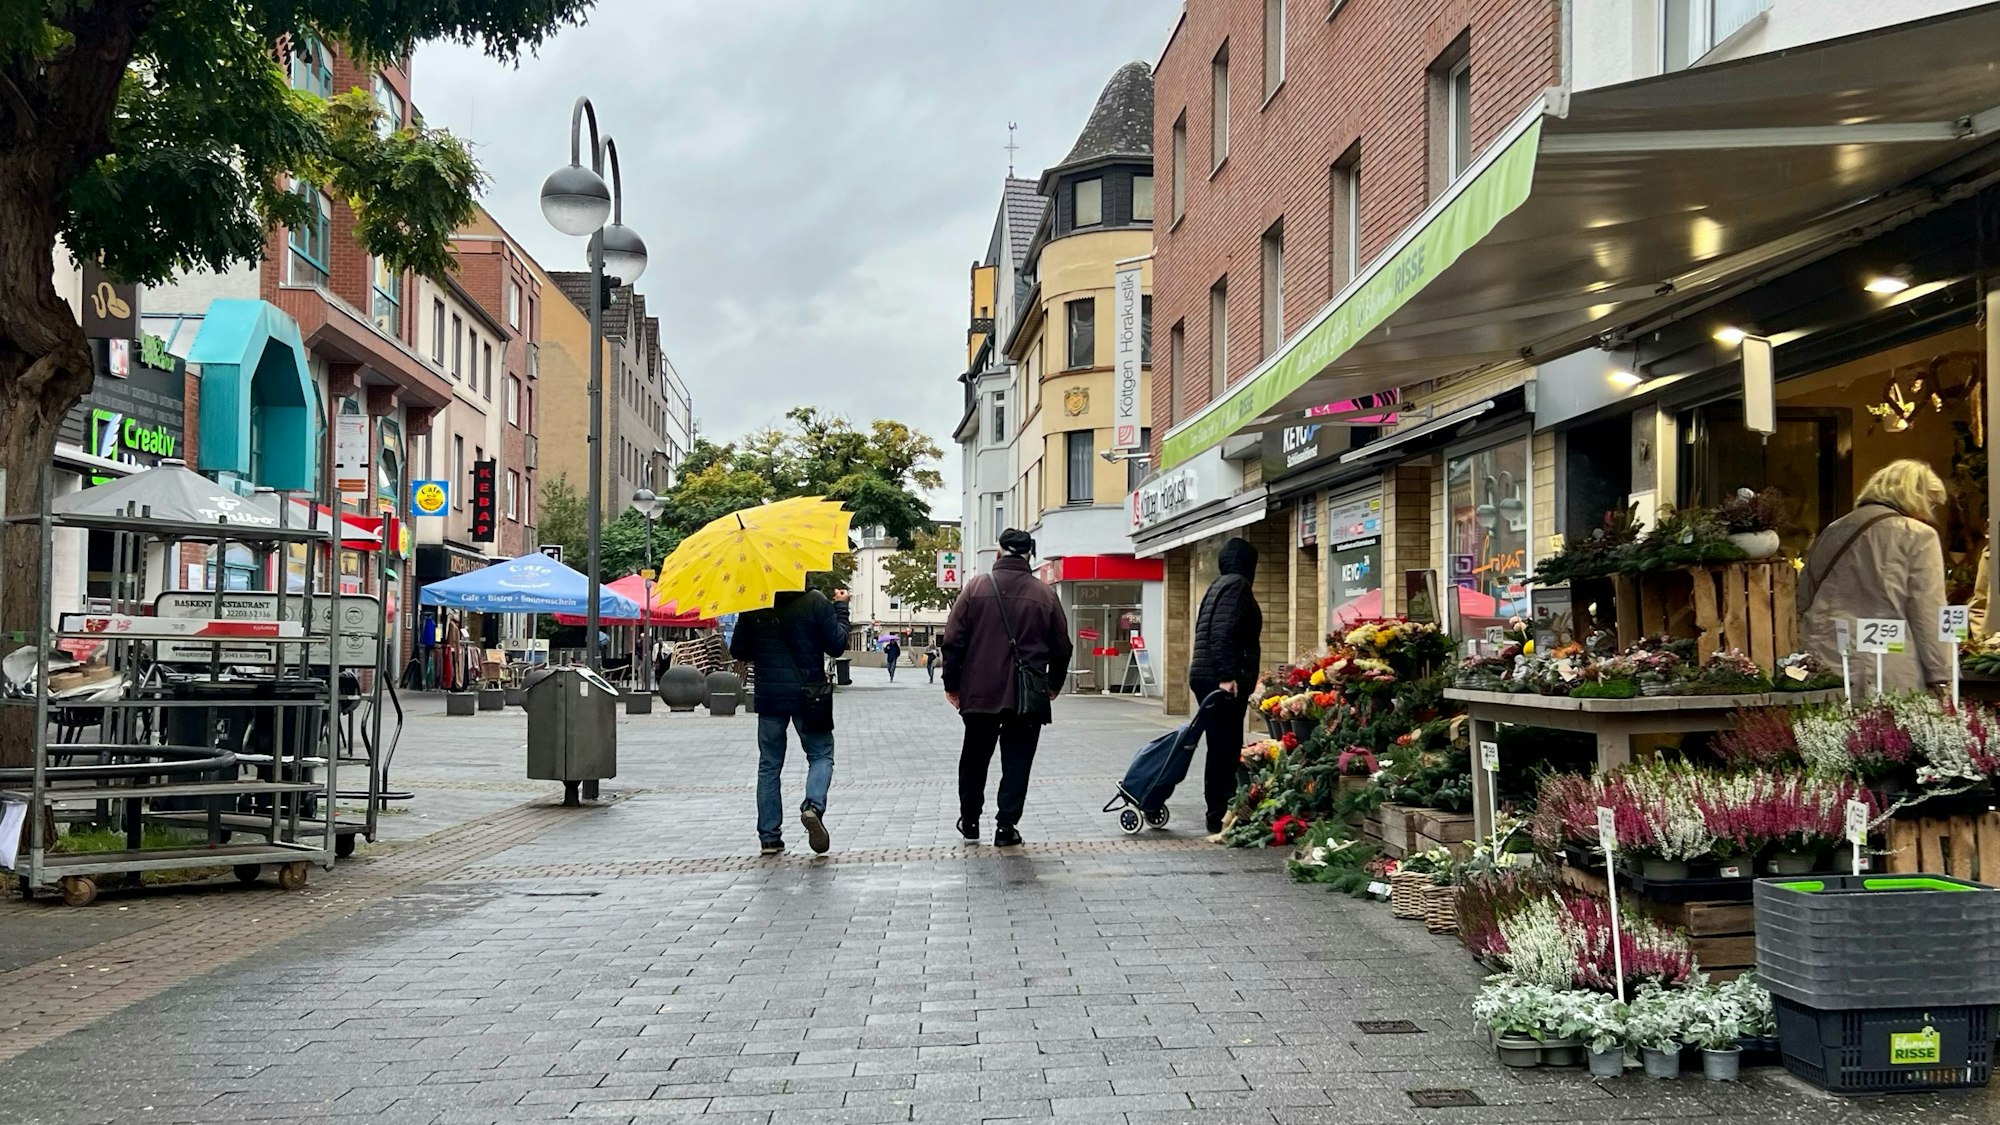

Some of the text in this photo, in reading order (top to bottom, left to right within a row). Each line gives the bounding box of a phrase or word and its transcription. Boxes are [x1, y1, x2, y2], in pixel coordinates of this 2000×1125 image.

[1395, 245, 1425, 297] RISSE
[1120, 273, 1136, 418] Köttgen Hörakustik
[123, 417, 175, 457] Creativ
[476, 468, 491, 535] KEBAP
[222, 601, 270, 609] ESTAURANT
[462, 593, 576, 605] Cafe Bistro Sonnenschein
[1862, 622, 1898, 645] 2.59
[1895, 1047, 1936, 1059] RISSE
